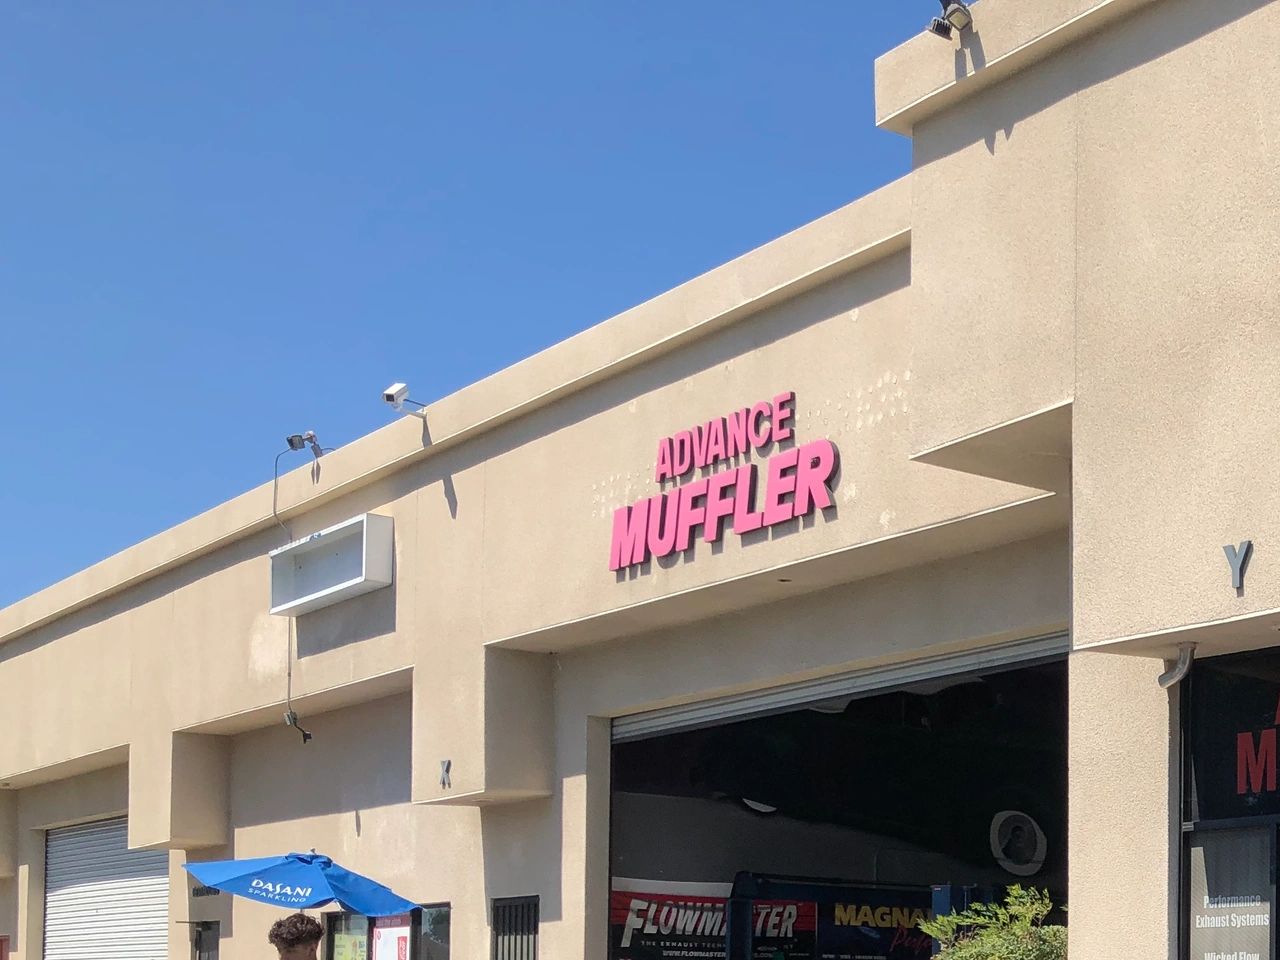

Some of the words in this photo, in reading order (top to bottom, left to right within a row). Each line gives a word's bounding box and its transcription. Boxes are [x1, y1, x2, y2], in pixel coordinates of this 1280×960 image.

[655, 391, 796, 484] ADVANCE
[609, 439, 837, 572] MUFFLER
[1222, 540, 1251, 589] Y
[248, 888, 307, 902] SPARKLING
[251, 879, 313, 897] DASANI
[1203, 894, 1261, 909] Performance
[620, 898, 798, 948] FLOWMTER
[1196, 914, 1229, 928] Exhaust
[1231, 913, 1270, 928] Systems
